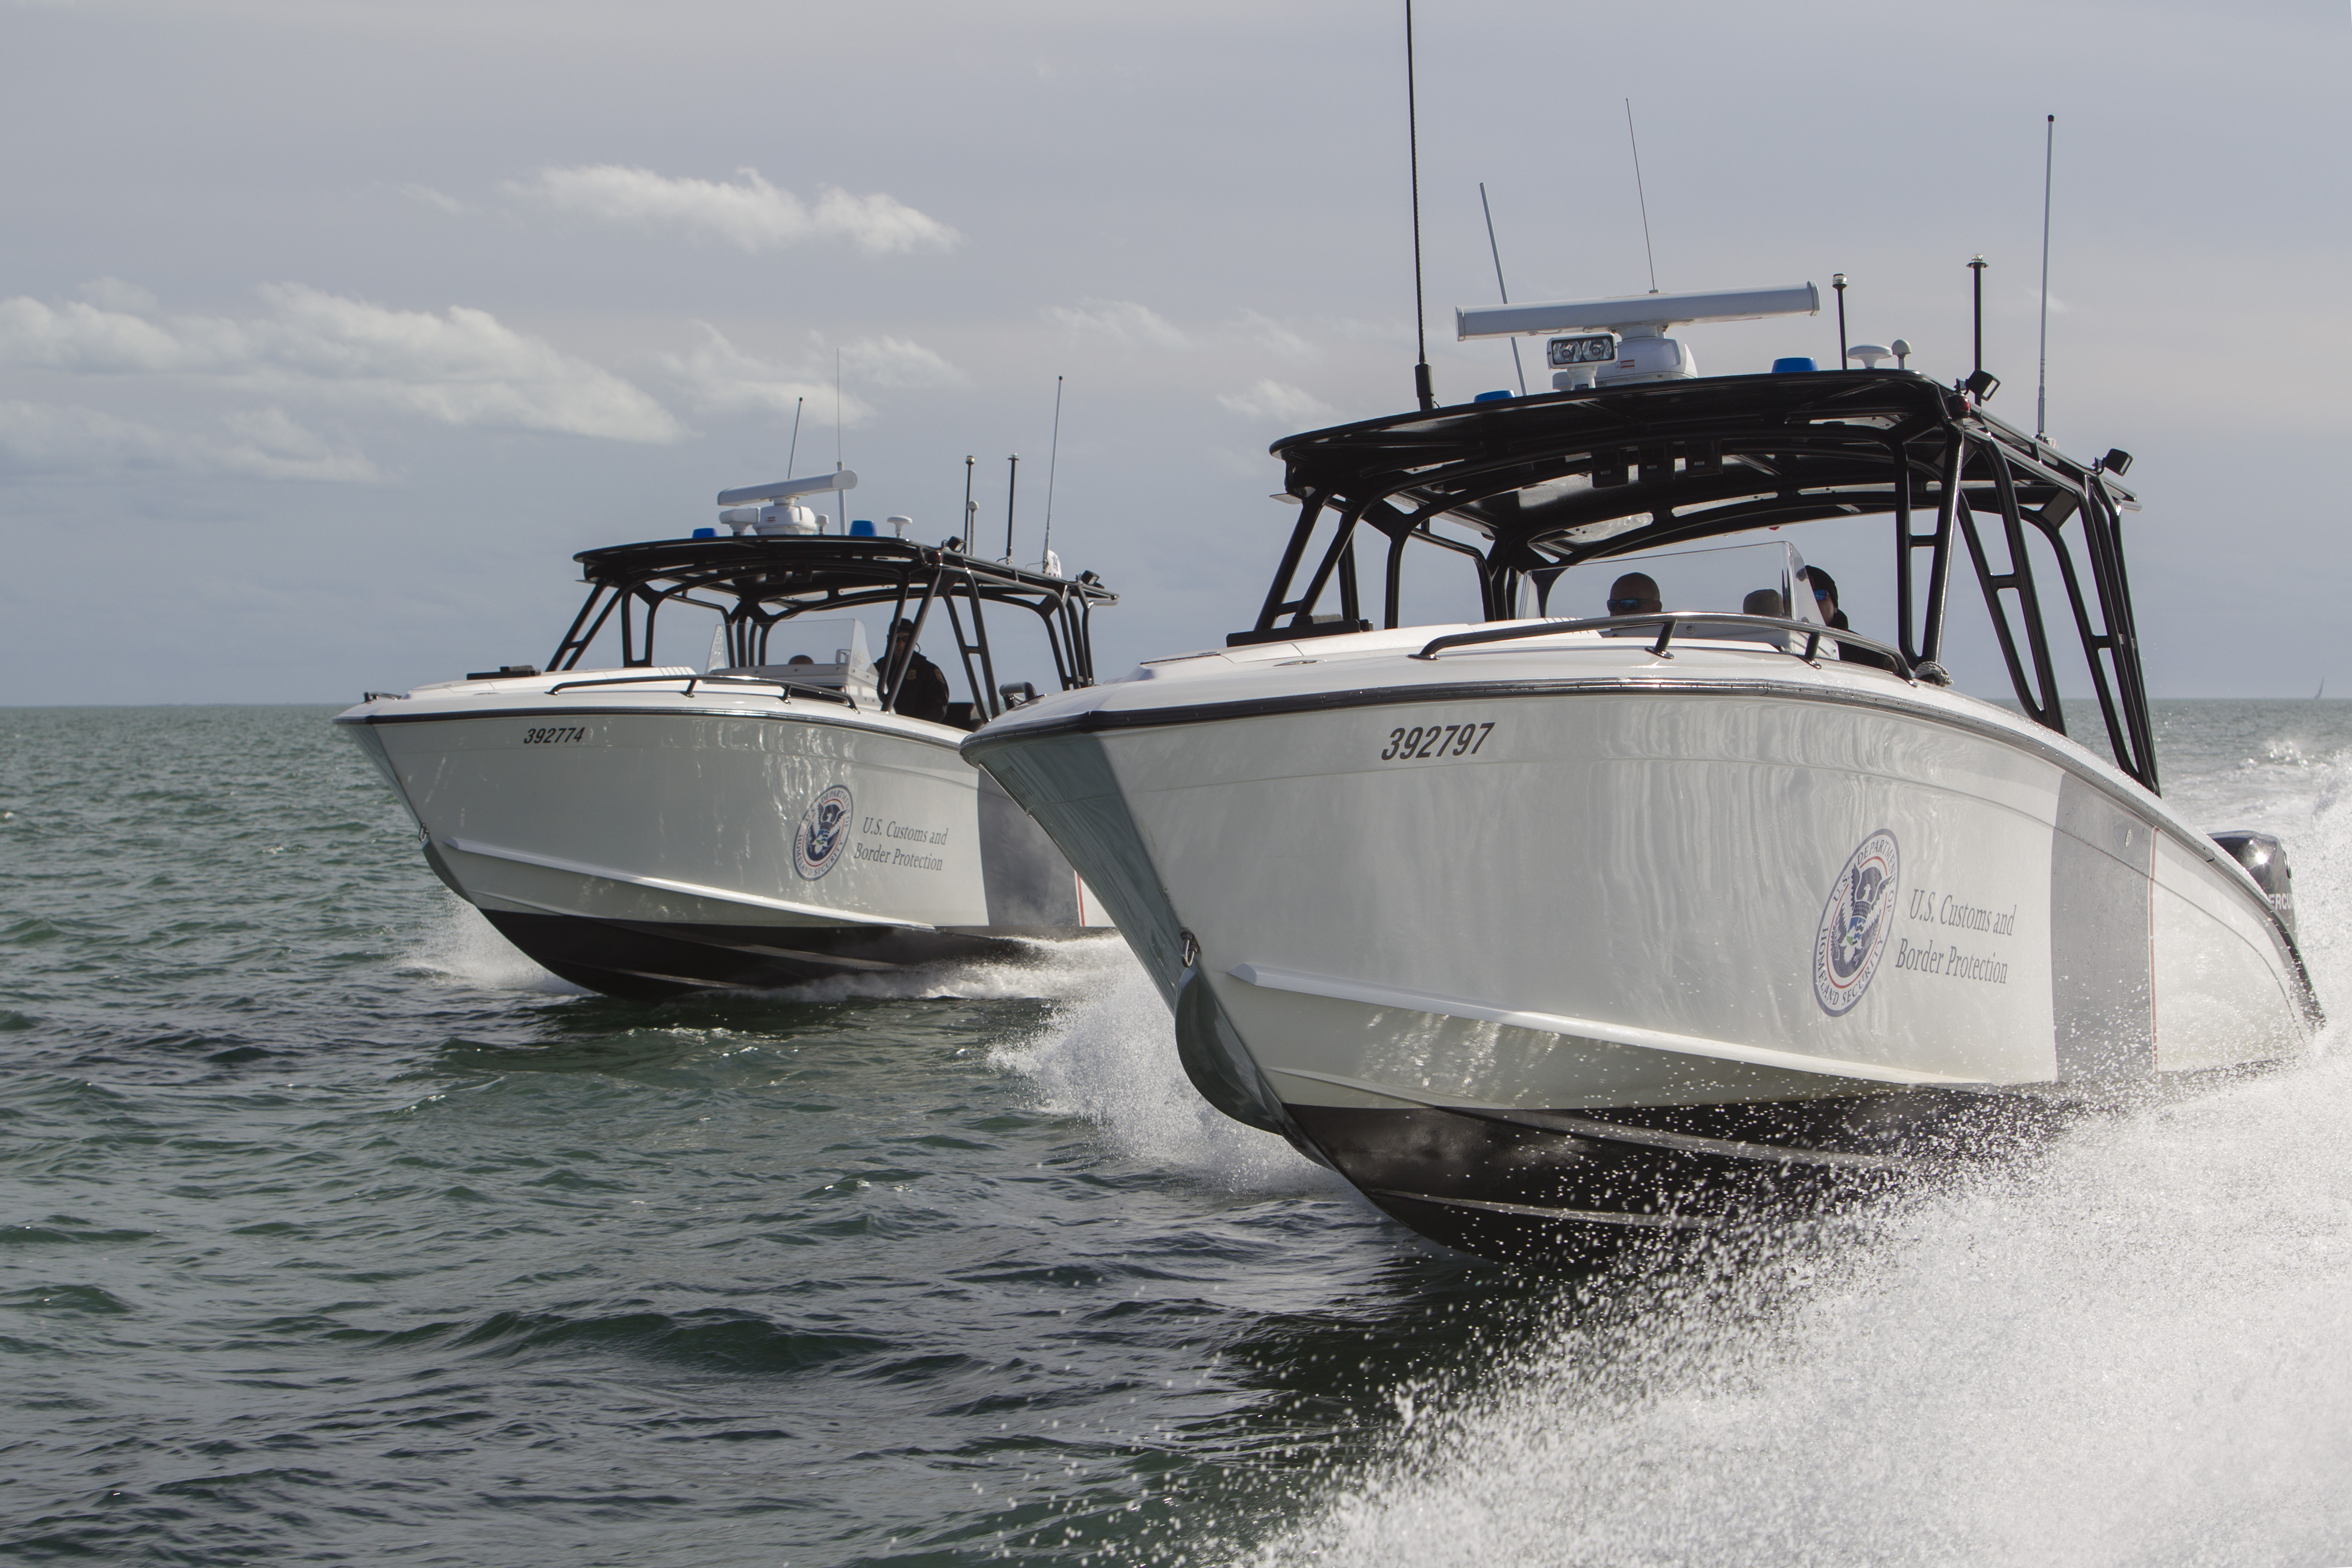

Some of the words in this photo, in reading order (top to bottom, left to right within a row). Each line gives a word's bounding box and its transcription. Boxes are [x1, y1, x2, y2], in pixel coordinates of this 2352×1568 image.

[523, 727, 585, 744] 392774
[1381, 722, 1496, 760] 392797
[844, 816, 850, 828] OF
[863, 817, 883, 836] U.S.
[886, 821, 928, 842] Customs
[929, 828, 949, 845] and
[796, 834, 813, 875] HOMELAND
[814, 841, 843, 876] SECURITY
[853, 842, 891, 863] Border
[892, 848, 943, 871] Protection
[1857, 839, 1896, 887] DEPARTMENT
[1886, 890, 1895, 912] OF
[1910, 889, 1936, 923] U.S.
[1940, 894, 1992, 932] Customs
[1993, 904, 2017, 936] and
[2268, 893, 2293, 910] ERCU
[1818, 926, 1839, 1005] HOMELAND
[1841, 935, 1883, 1006] SECURITY
[1895, 938, 1944, 974] Border
[1945, 946, 2008, 984] Protection
